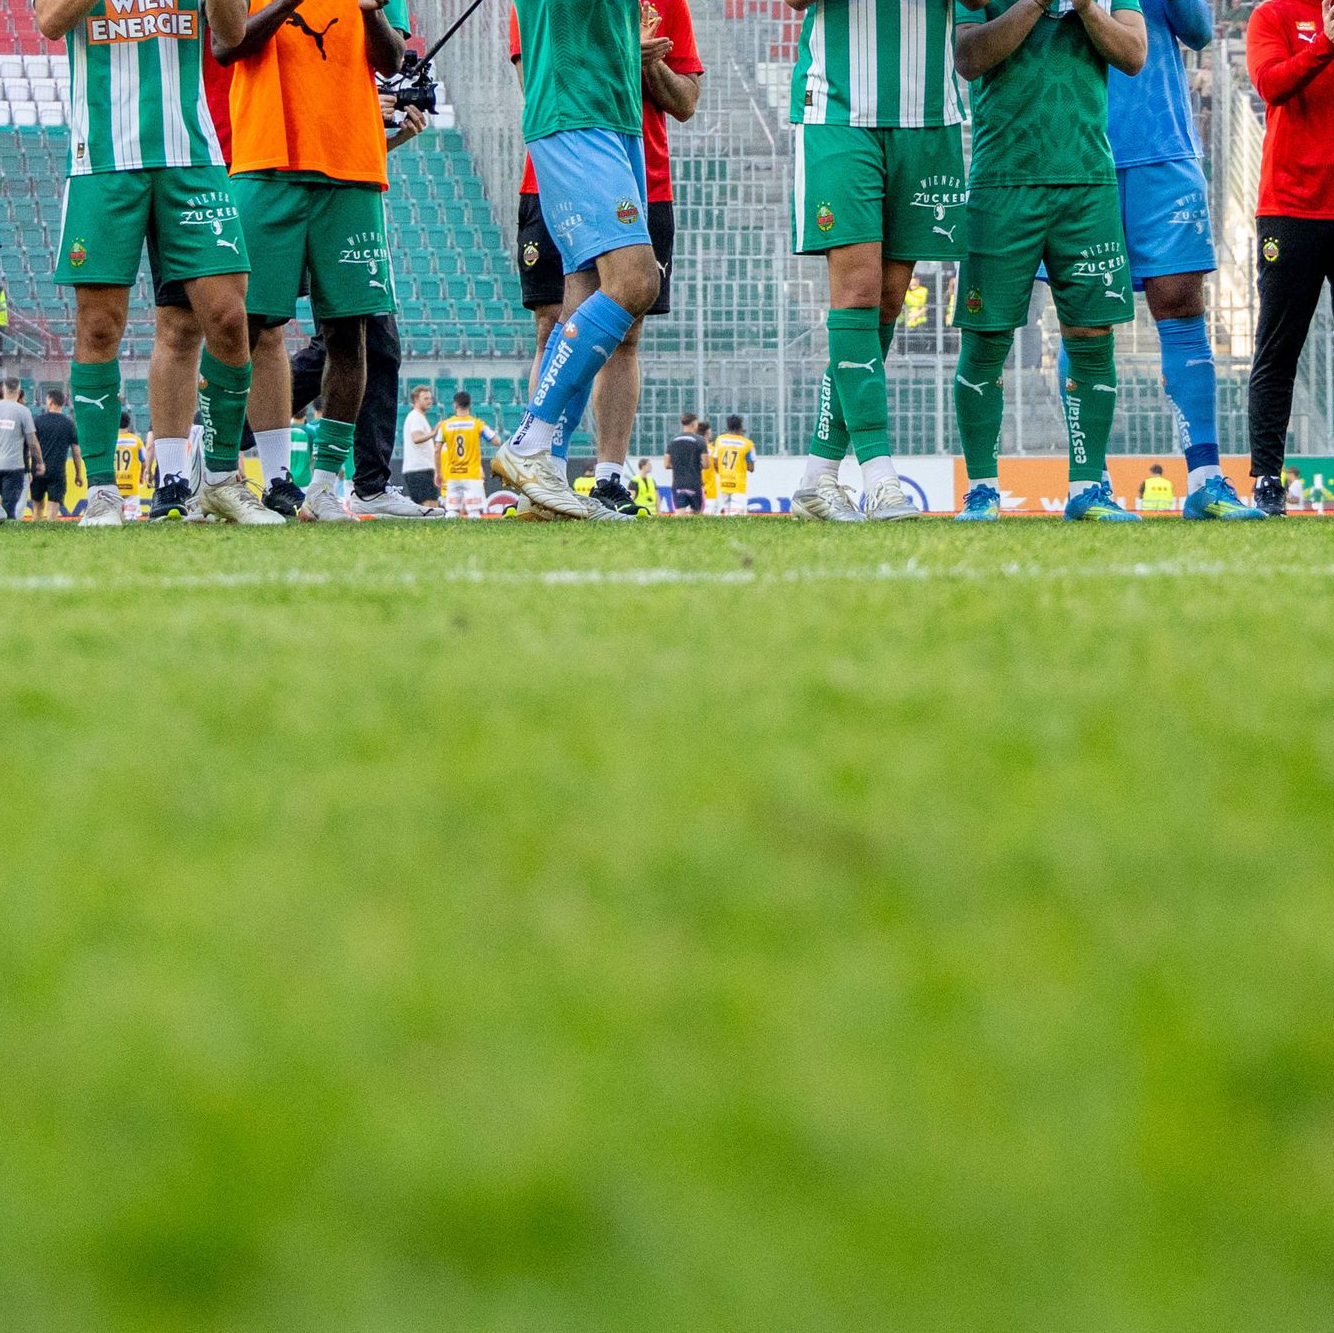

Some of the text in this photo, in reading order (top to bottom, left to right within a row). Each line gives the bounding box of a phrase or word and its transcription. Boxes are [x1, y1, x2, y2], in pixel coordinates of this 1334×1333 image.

[91, 12, 194, 41] ENERGIE
[920, 175, 961, 189] WIENER
[186, 191, 230, 208] WIENER
[911, 192, 967, 207] ZUCKER
[179, 207, 238, 224] ZUCKER
[1168, 210, 1206, 223] ZUCK
[534, 339, 574, 407] easystaff
[1067, 396, 1087, 464] easystaff
[456, 435, 465, 457] 8
[115, 449, 131, 471] 19
[722, 449, 738, 471] 47
